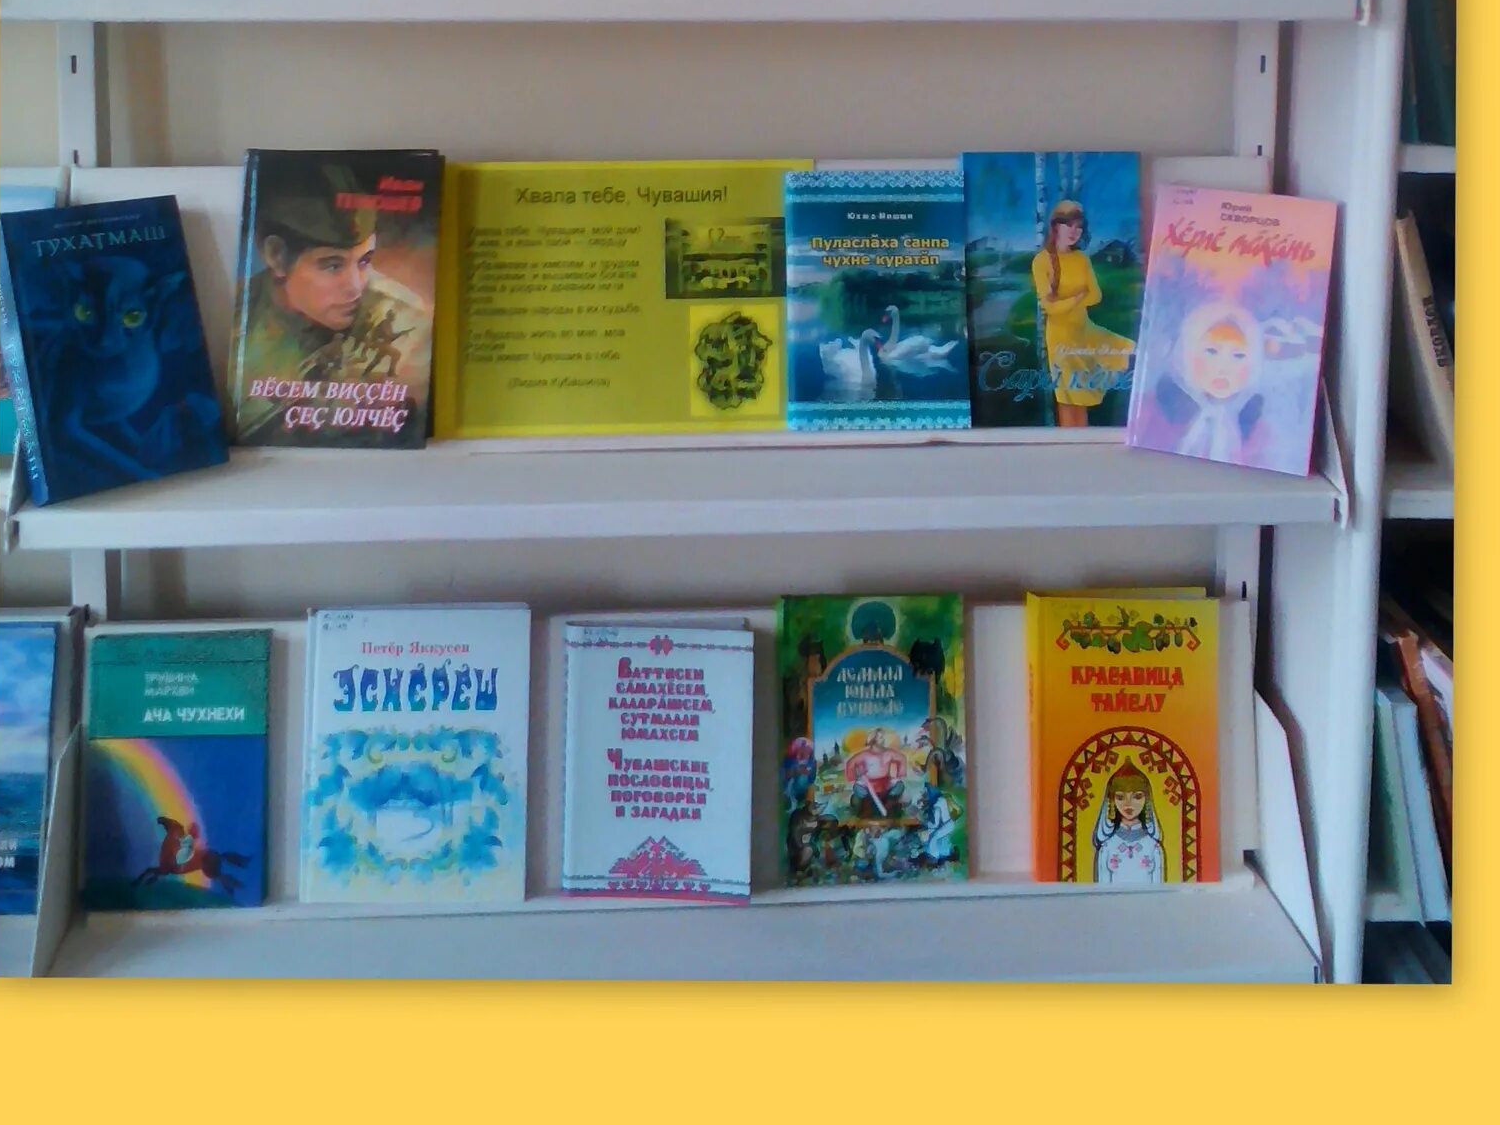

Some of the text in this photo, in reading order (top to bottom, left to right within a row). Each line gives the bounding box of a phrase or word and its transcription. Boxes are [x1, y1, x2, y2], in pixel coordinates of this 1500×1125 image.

[516, 188, 577, 205] Хвала
[637, 186, 728, 207] Чувашия!
[903, 236, 950, 249] санпа
[822, 254, 870, 269] чухне
[1071, 666, 1184, 690] КРАСАВИЦА
[143, 706, 246, 723] АЧА ЧУХНЕХИ
